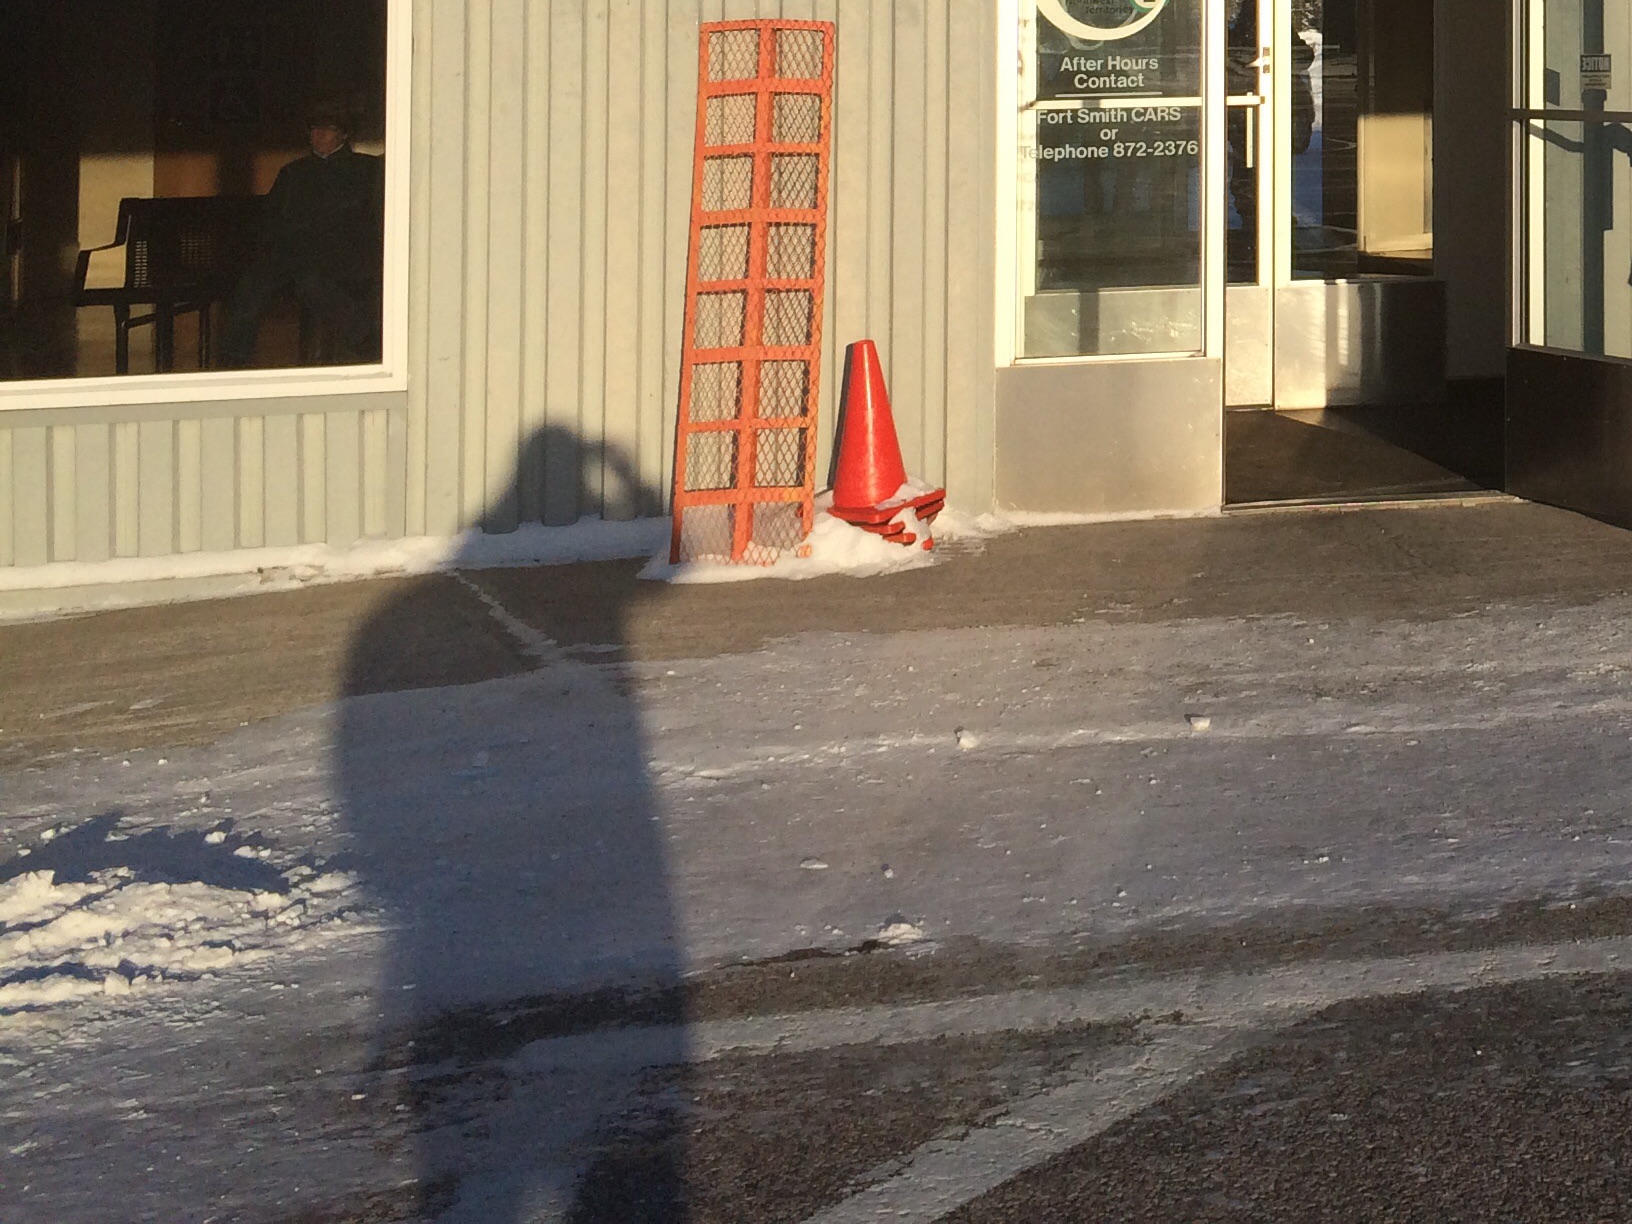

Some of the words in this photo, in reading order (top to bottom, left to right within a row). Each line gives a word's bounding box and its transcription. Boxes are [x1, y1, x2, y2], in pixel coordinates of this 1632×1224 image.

[1060, 57, 1103, 72] After
[1107, 55, 1159, 71] Hours
[1074, 73, 1144, 89] Contact
[1037, 109, 1073, 125] Fort
[1077, 108, 1127, 123] Smith
[1131, 106, 1182, 122] CARS
[1100, 128, 1119, 141] or
[1020, 143, 1109, 162] Telephone
[1113, 140, 1199, 158] 872-2376
